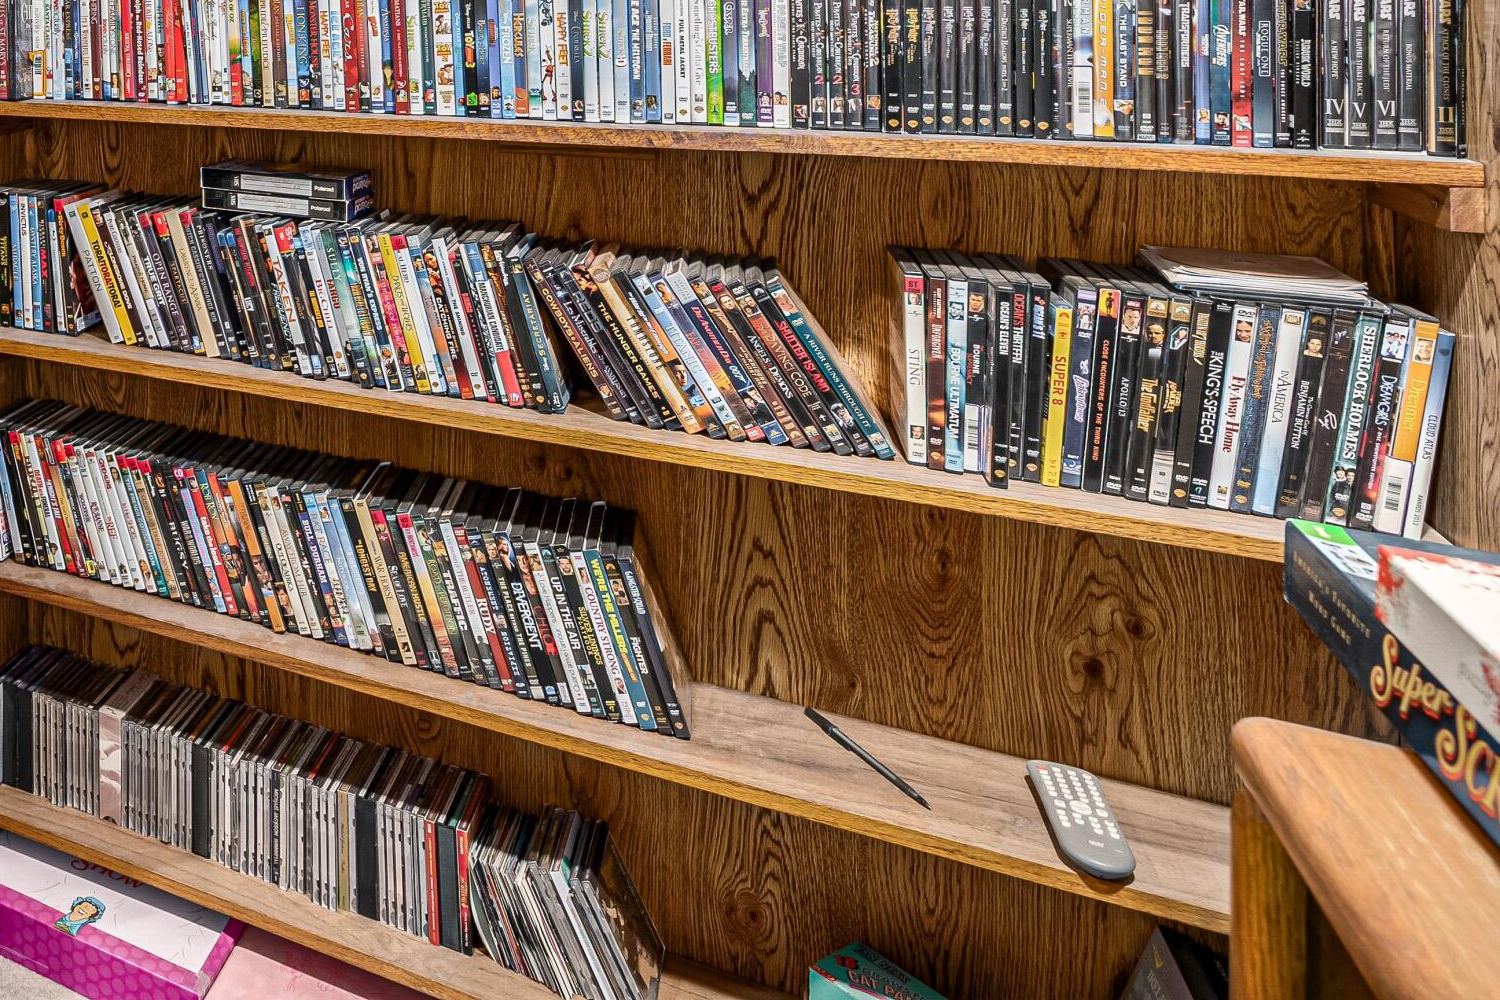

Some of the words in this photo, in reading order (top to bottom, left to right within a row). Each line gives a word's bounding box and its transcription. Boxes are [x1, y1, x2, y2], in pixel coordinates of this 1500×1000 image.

[1179, 2, 1190, 68] TRANSFORMERS
[1260, 23, 1270, 54] ROGUE
[1260, 56, 1270, 75] ONE
[1325, 98, 1344, 116] IV
[83, 250, 103, 292] PATTON
[271, 256, 296, 323] TAKEN
[598, 304, 612, 322] THE
[609, 323, 637, 363] HUNGER
[635, 363, 661, 400] GAMES
[776, 319, 807, 362] SHUTTER
[802, 358, 830, 393] ISLAND
[908, 348, 921, 386] STING
[1052, 356, 1067, 396] SUPER
[1206, 355, 1224, 401] KING'S
[1354, 326, 1377, 396] SHERLOCK
[1199, 399, 1218, 445] SPEECH
[1343, 398, 1366, 461] HOLMES
[511, 582, 543, 650] DIVERGENT
[1371, 634, 1452, 714] Super
